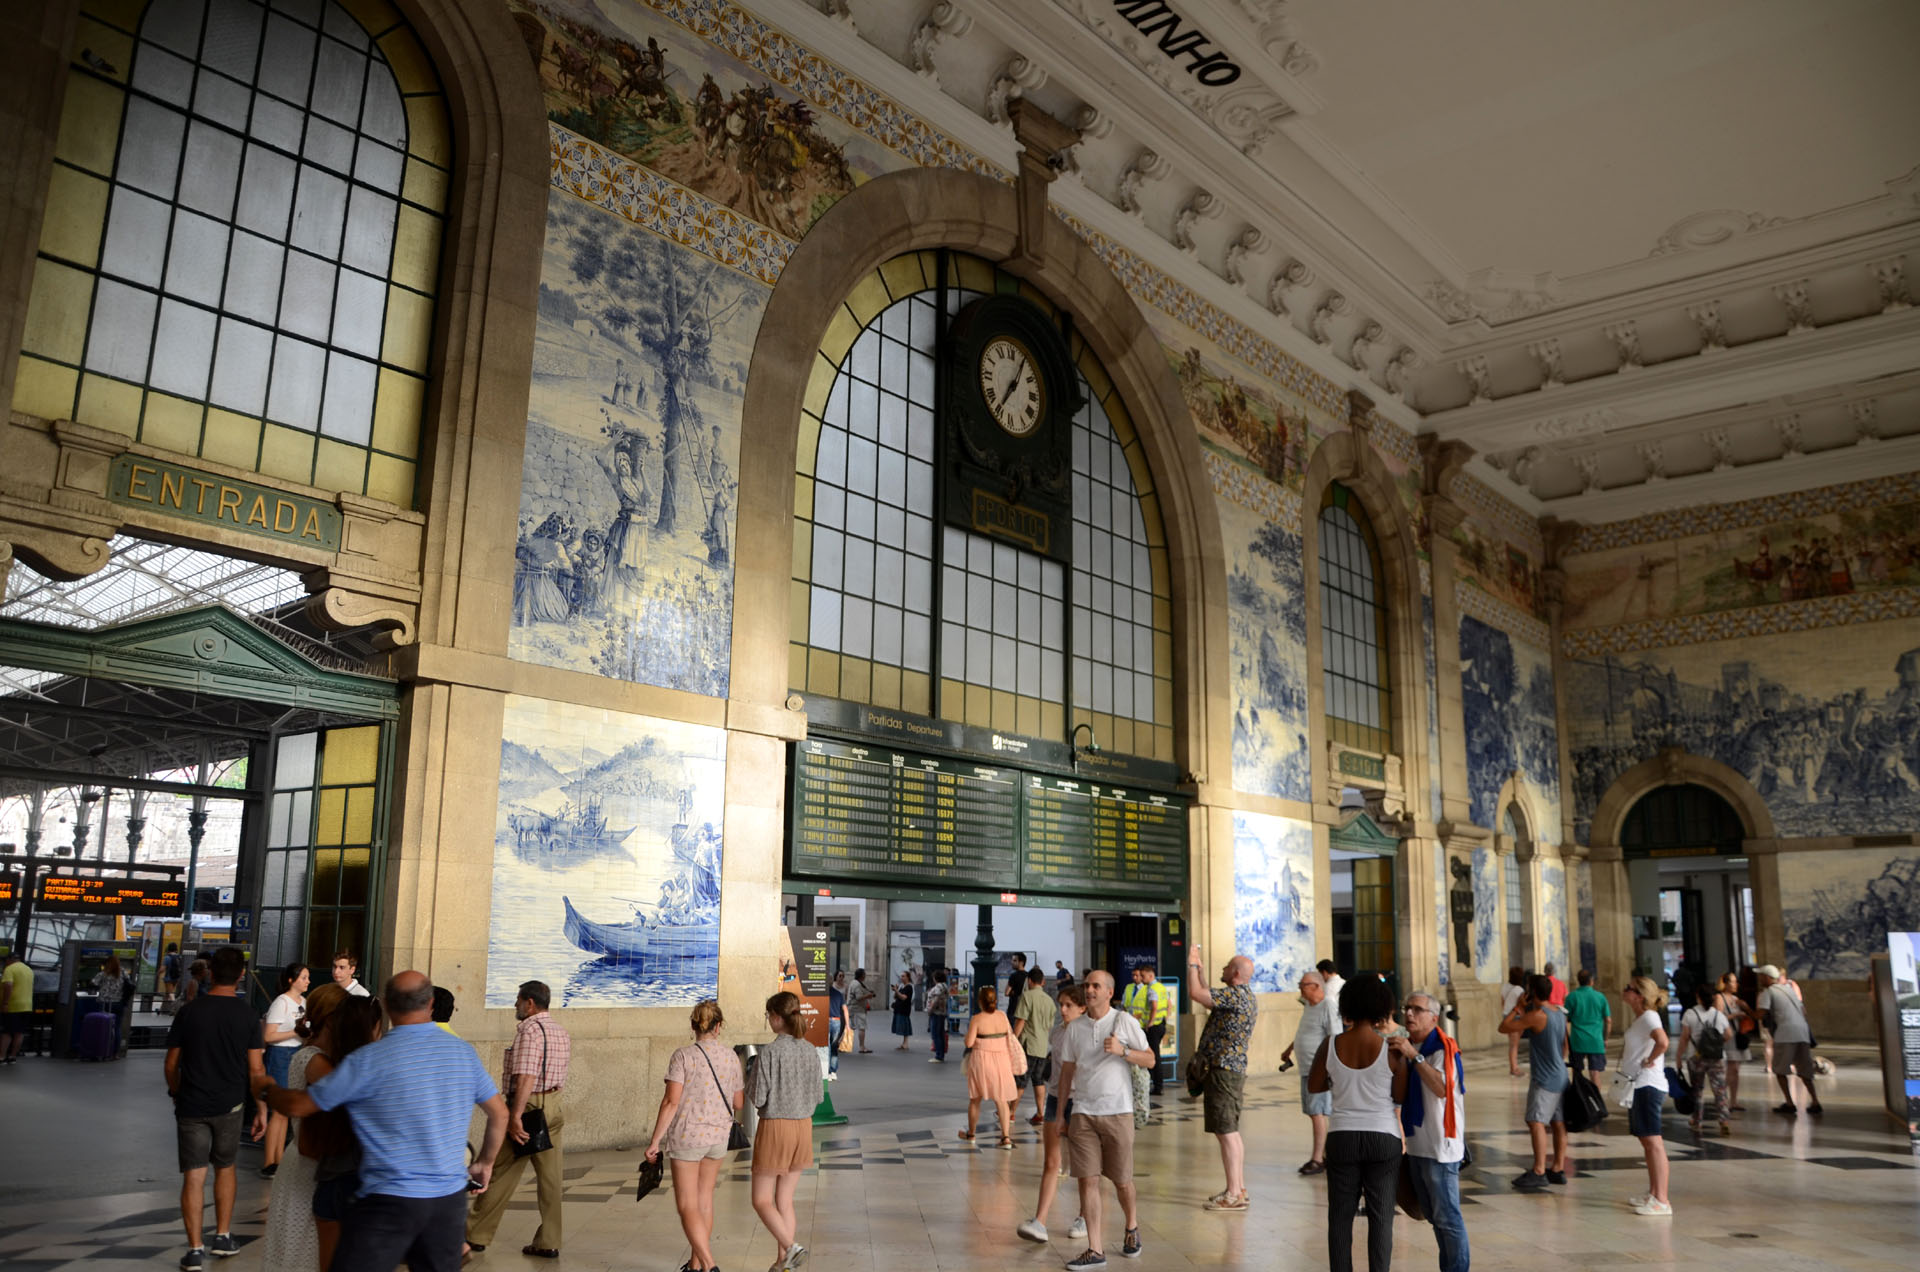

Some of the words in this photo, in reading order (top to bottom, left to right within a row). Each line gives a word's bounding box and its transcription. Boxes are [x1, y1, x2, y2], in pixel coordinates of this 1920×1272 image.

[128, 463, 322, 541] ENTRADA
[984, 497, 1038, 538] PORTO
[868, 712, 902, 730] Partidas
[907, 723, 943, 737] Departures
[46, 878, 79, 888] PARTIDA
[45, 886, 86, 894] GUIMARAES
[118, 889, 144, 898] SUBURB
[141, 898, 179, 907] GIESTEIRA
[813, 950, 826, 961] 2€
[1124, 954, 1156, 965] HeyPorto
